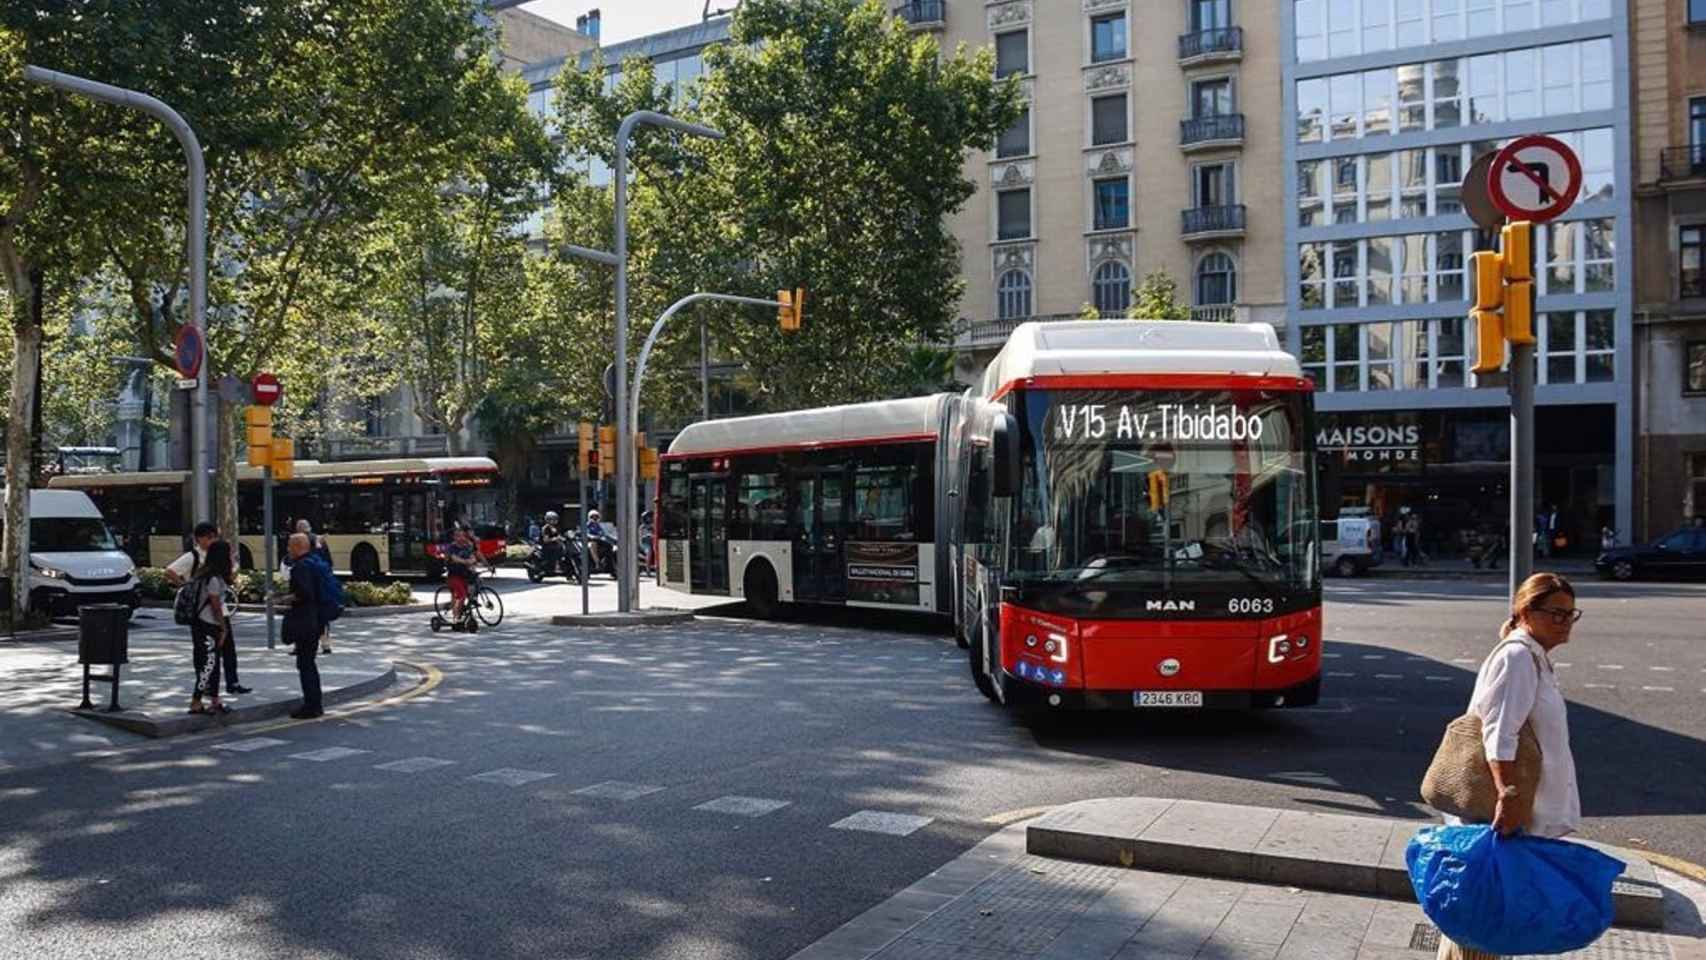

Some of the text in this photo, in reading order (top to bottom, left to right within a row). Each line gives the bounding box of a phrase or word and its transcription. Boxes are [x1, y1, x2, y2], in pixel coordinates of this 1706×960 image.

[1060, 404, 1106, 438] V15
[1346, 450, 1418, 461] MONDE
[1146, 600, 1195, 611] MAN
[1228, 598, 1274, 613] 6063
[1143, 693, 1173, 705] 2346
